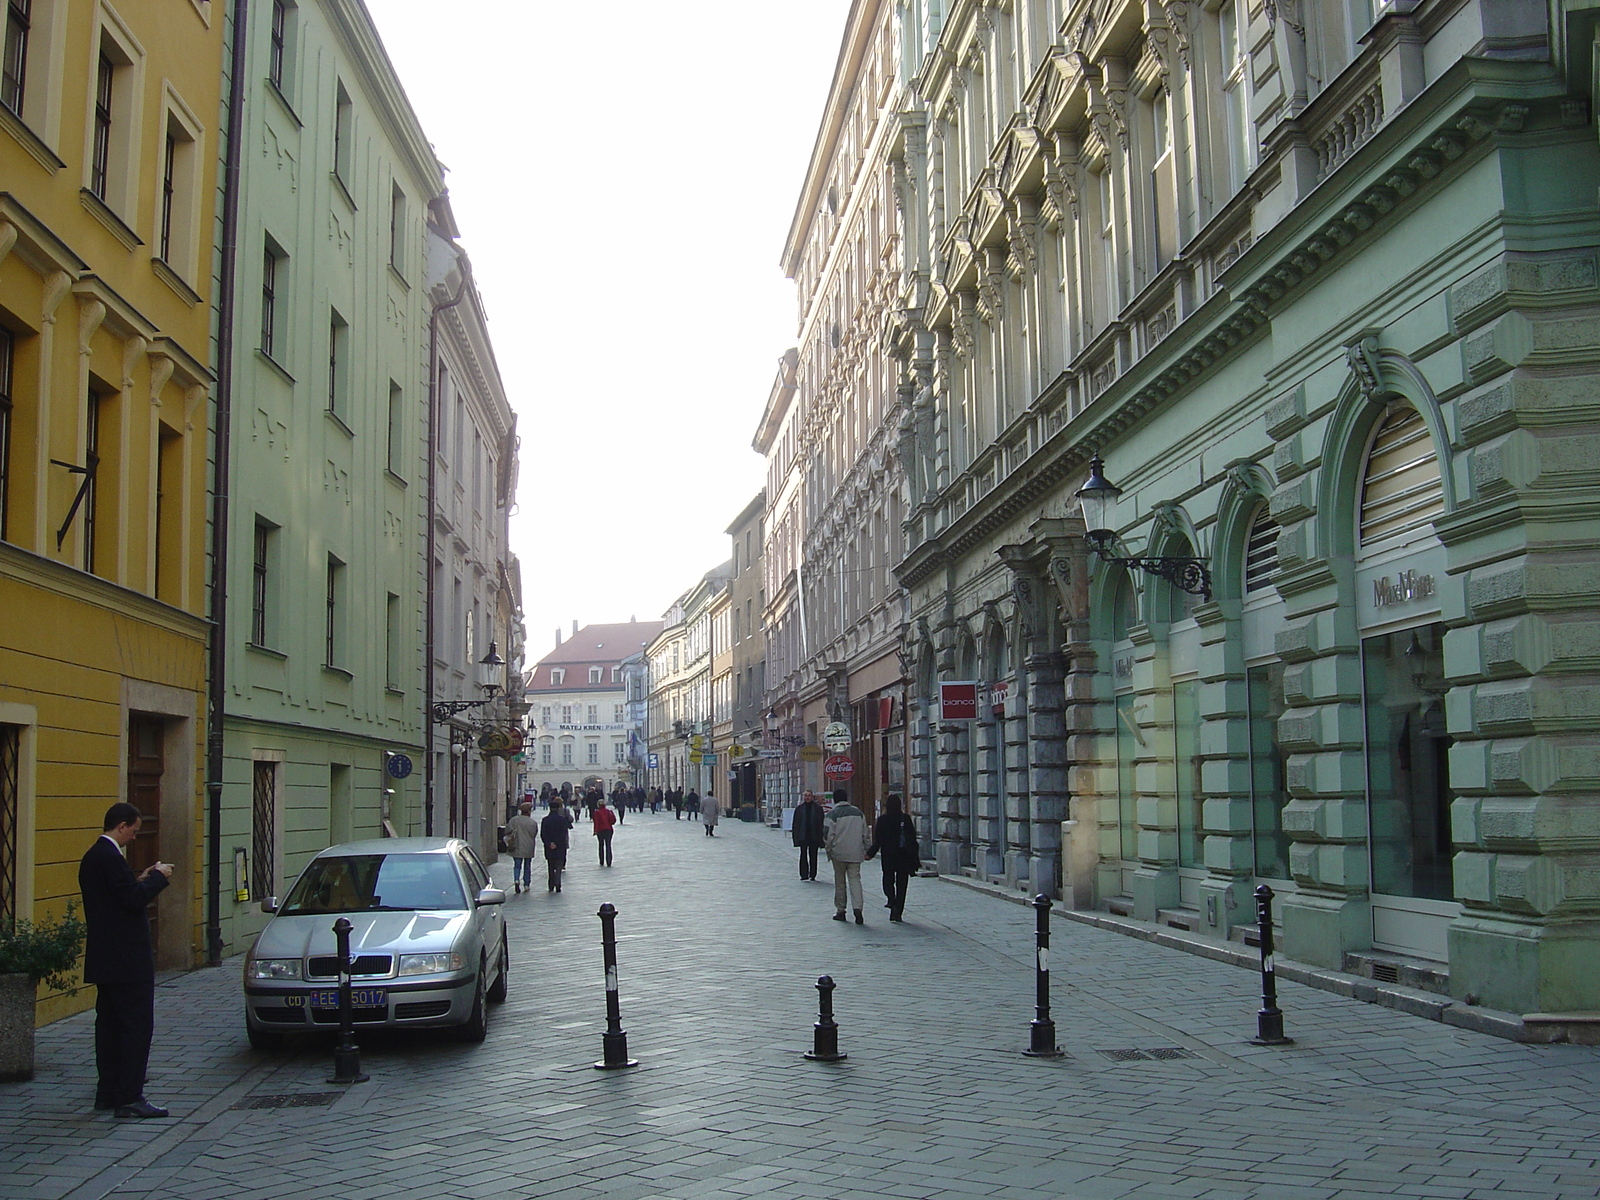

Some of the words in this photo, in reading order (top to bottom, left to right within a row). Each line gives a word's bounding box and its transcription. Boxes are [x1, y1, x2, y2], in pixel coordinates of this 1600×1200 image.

[288, 996, 301, 1006] CD
[319, 992, 336, 1005] EE
[351, 990, 384, 1004] 5017
